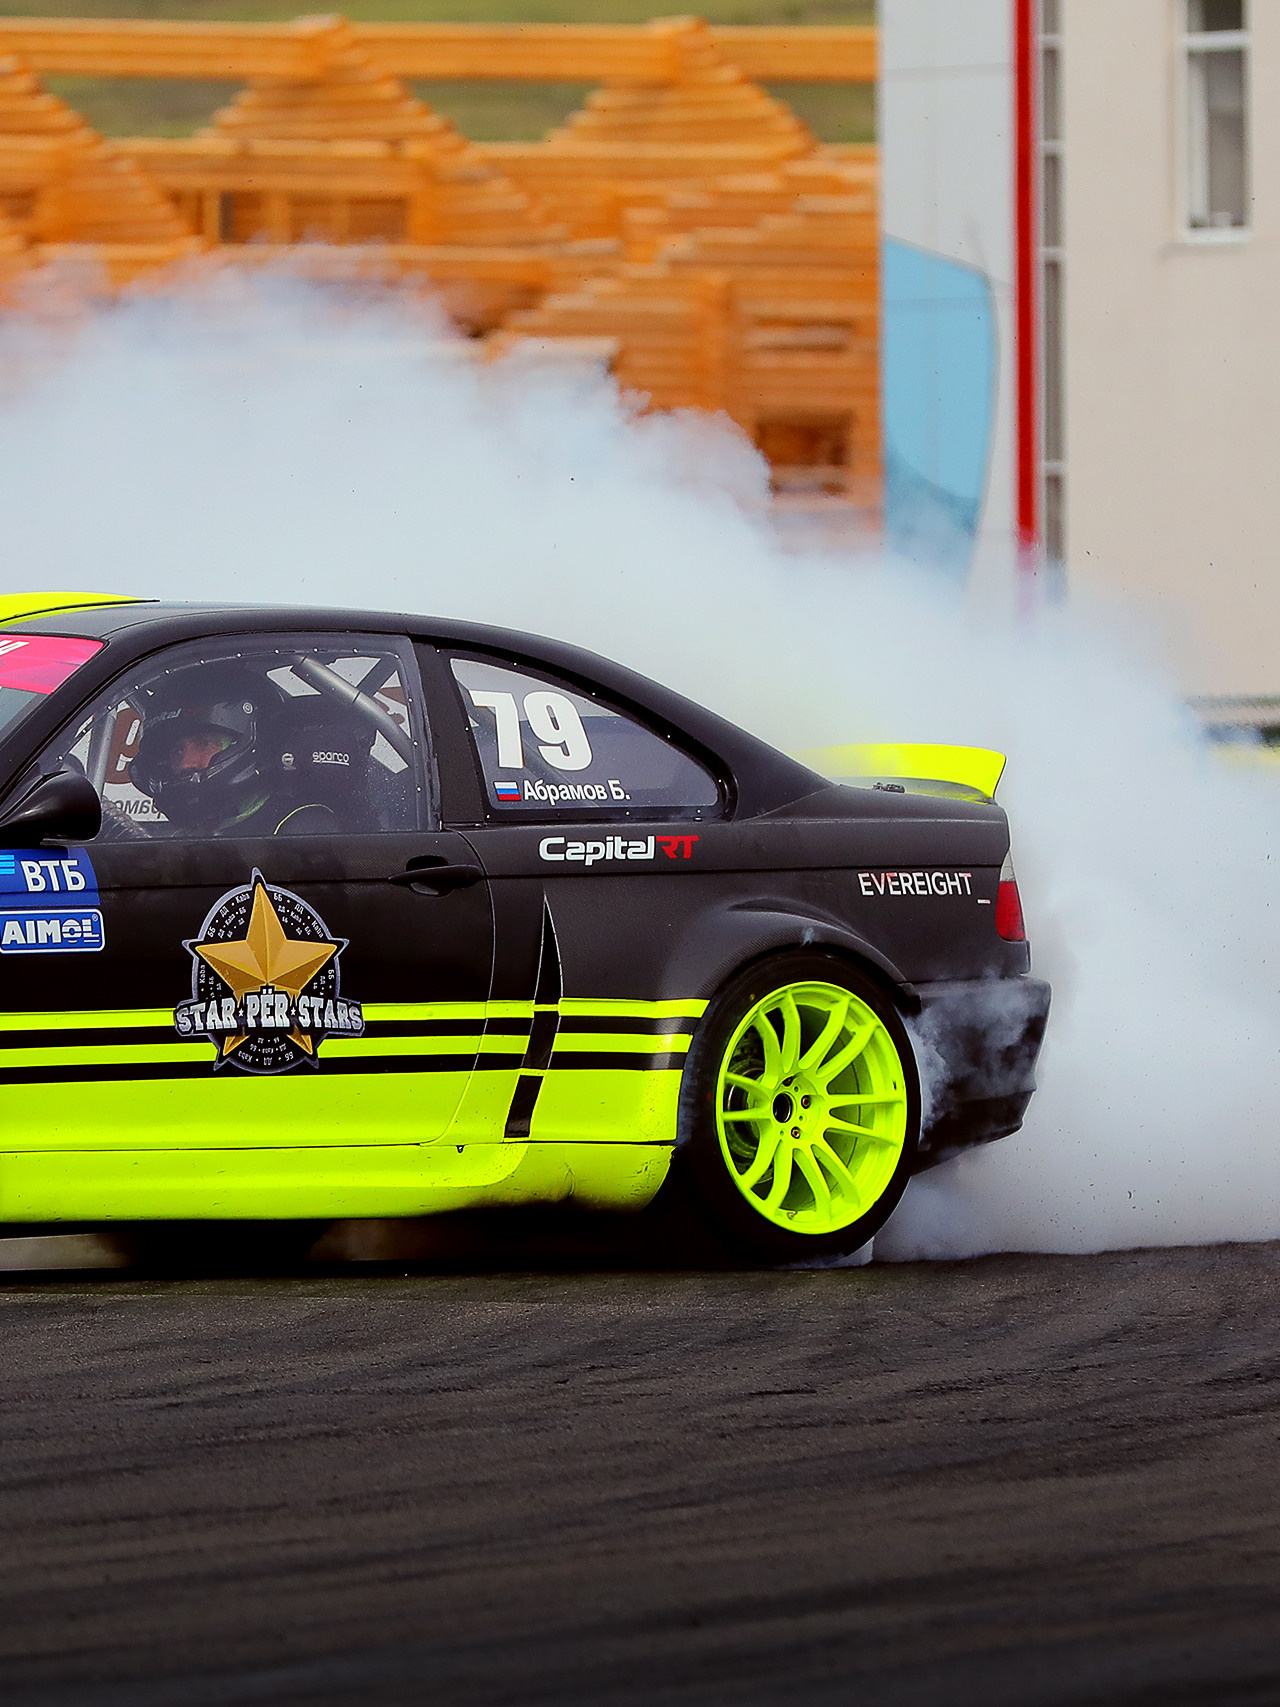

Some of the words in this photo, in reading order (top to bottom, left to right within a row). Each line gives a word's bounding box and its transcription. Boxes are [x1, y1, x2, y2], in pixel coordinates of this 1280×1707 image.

[469, 690, 593, 771] 79
[312, 751, 350, 766] sparco
[523, 779, 608, 806] Абрамов
[608, 779, 631, 801] Б.
[20, 859, 86, 892] ВТБ
[857, 872, 972, 896] EVEREIGHT
[1, 918, 100, 945] AIMOL
[176, 997, 238, 1032] STAR
[246, 988, 291, 1028] PËR
[298, 995, 363, 1031] STARS
